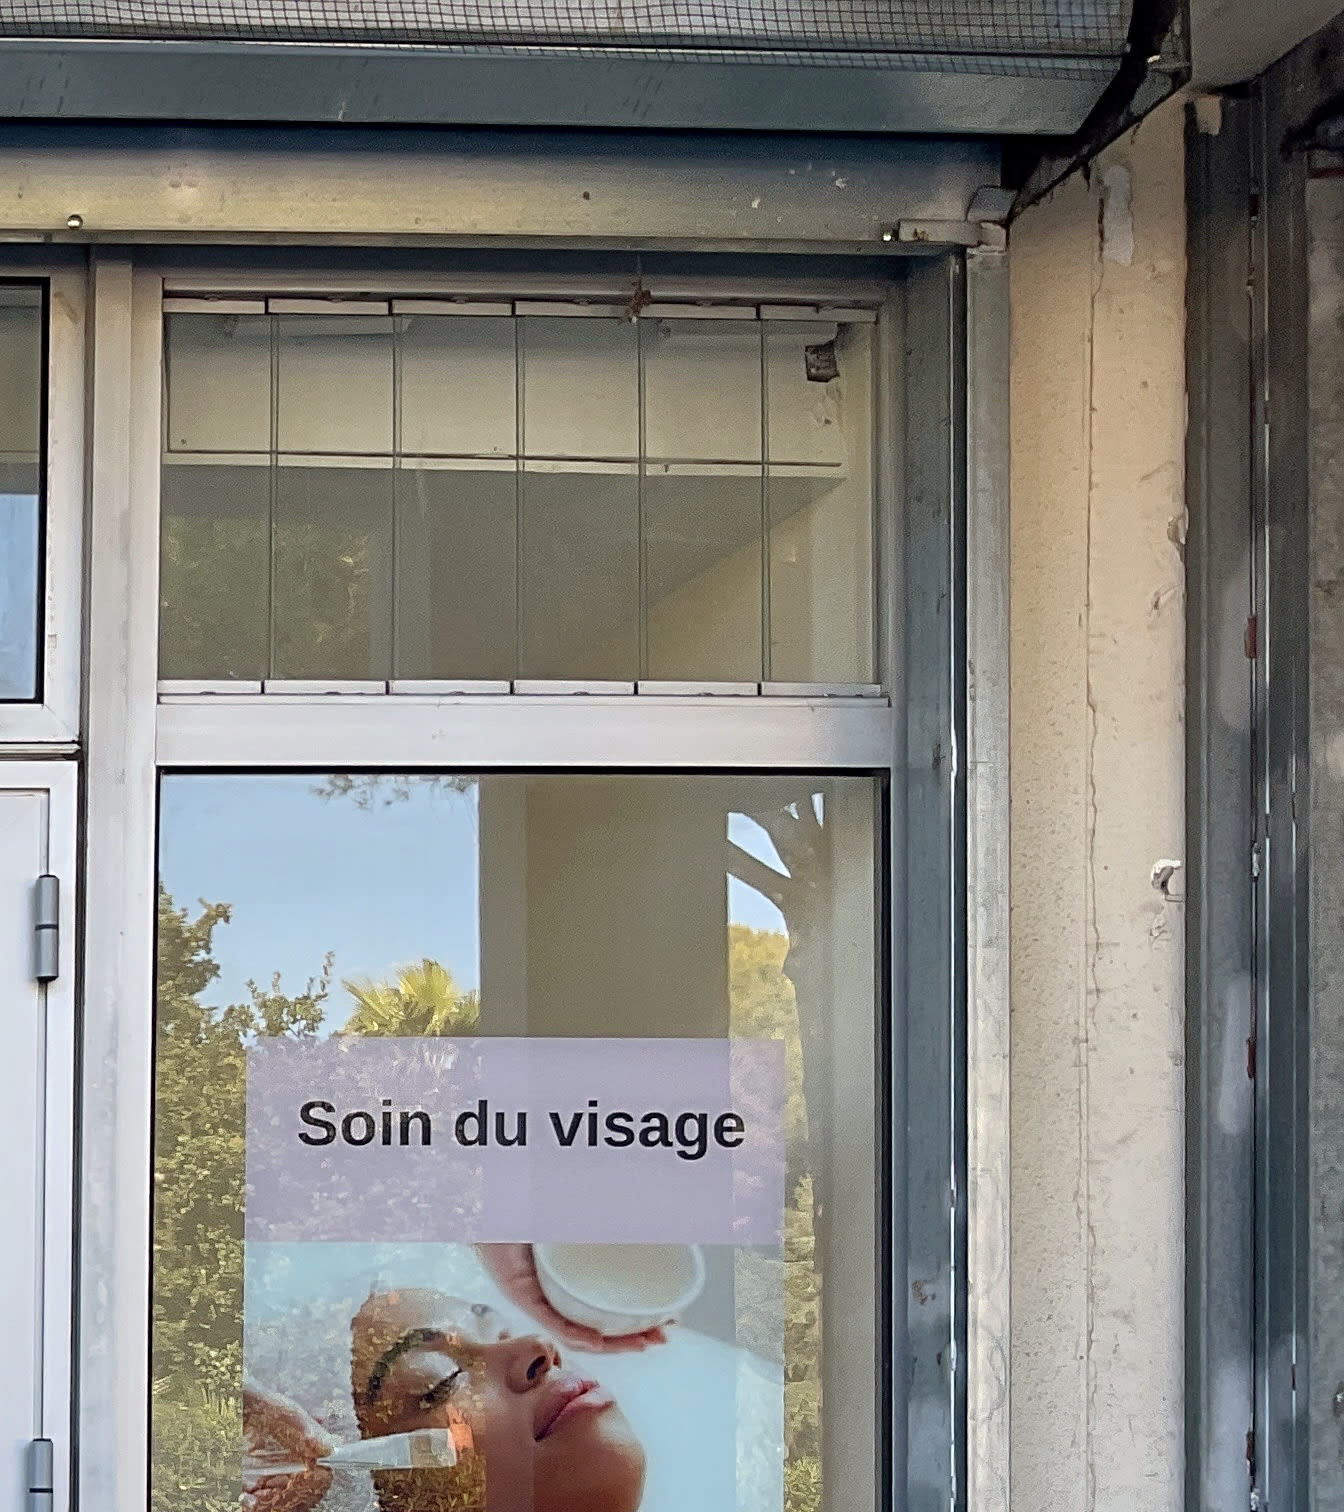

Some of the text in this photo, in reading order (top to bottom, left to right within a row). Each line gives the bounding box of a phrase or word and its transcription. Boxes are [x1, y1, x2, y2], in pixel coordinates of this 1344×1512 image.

[298, 1100, 746, 1161] Soin du visage
